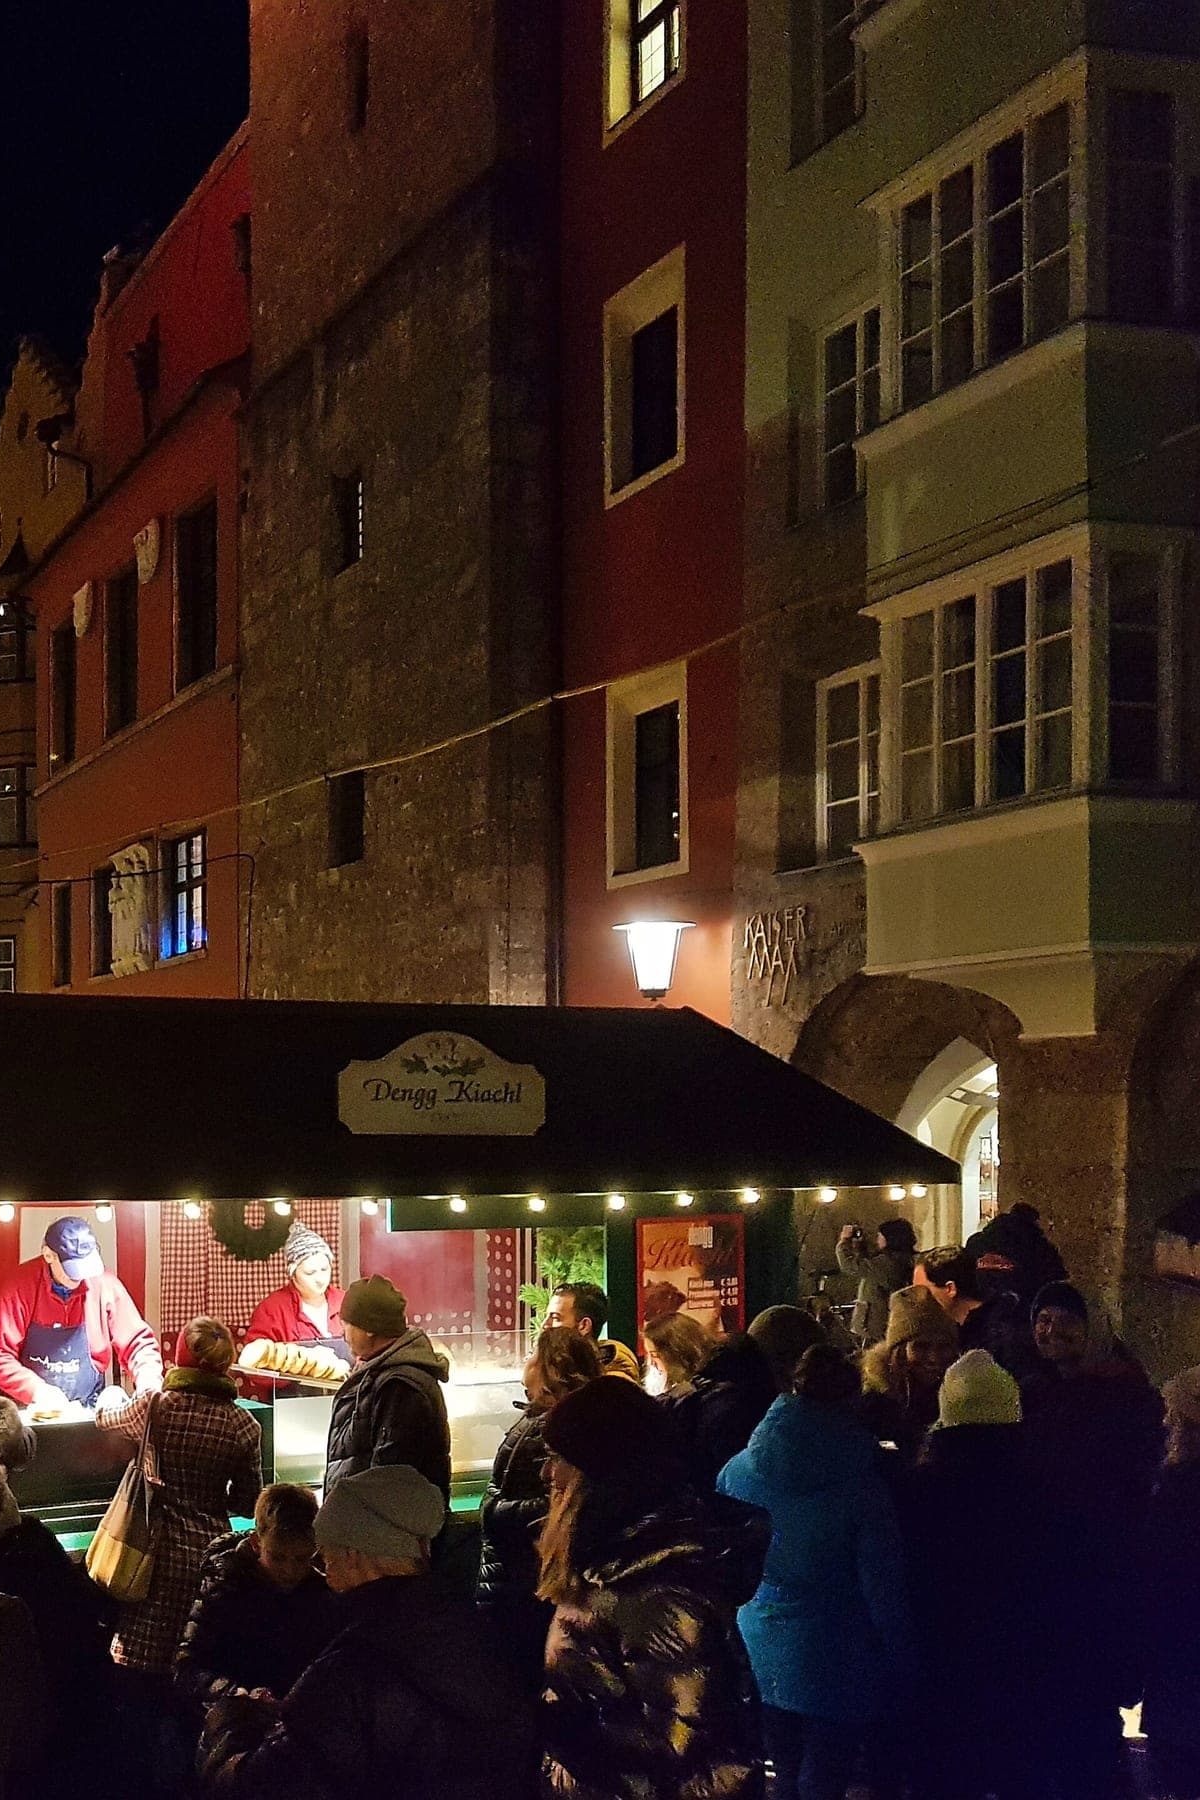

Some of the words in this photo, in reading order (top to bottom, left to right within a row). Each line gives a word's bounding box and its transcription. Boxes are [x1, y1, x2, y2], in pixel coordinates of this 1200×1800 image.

[743, 905, 807, 949] KAISER
[747, 939, 799, 1008] MAX
[362, 1078, 438, 1110] Dengg
[444, 1080, 523, 1104] Kiachl
